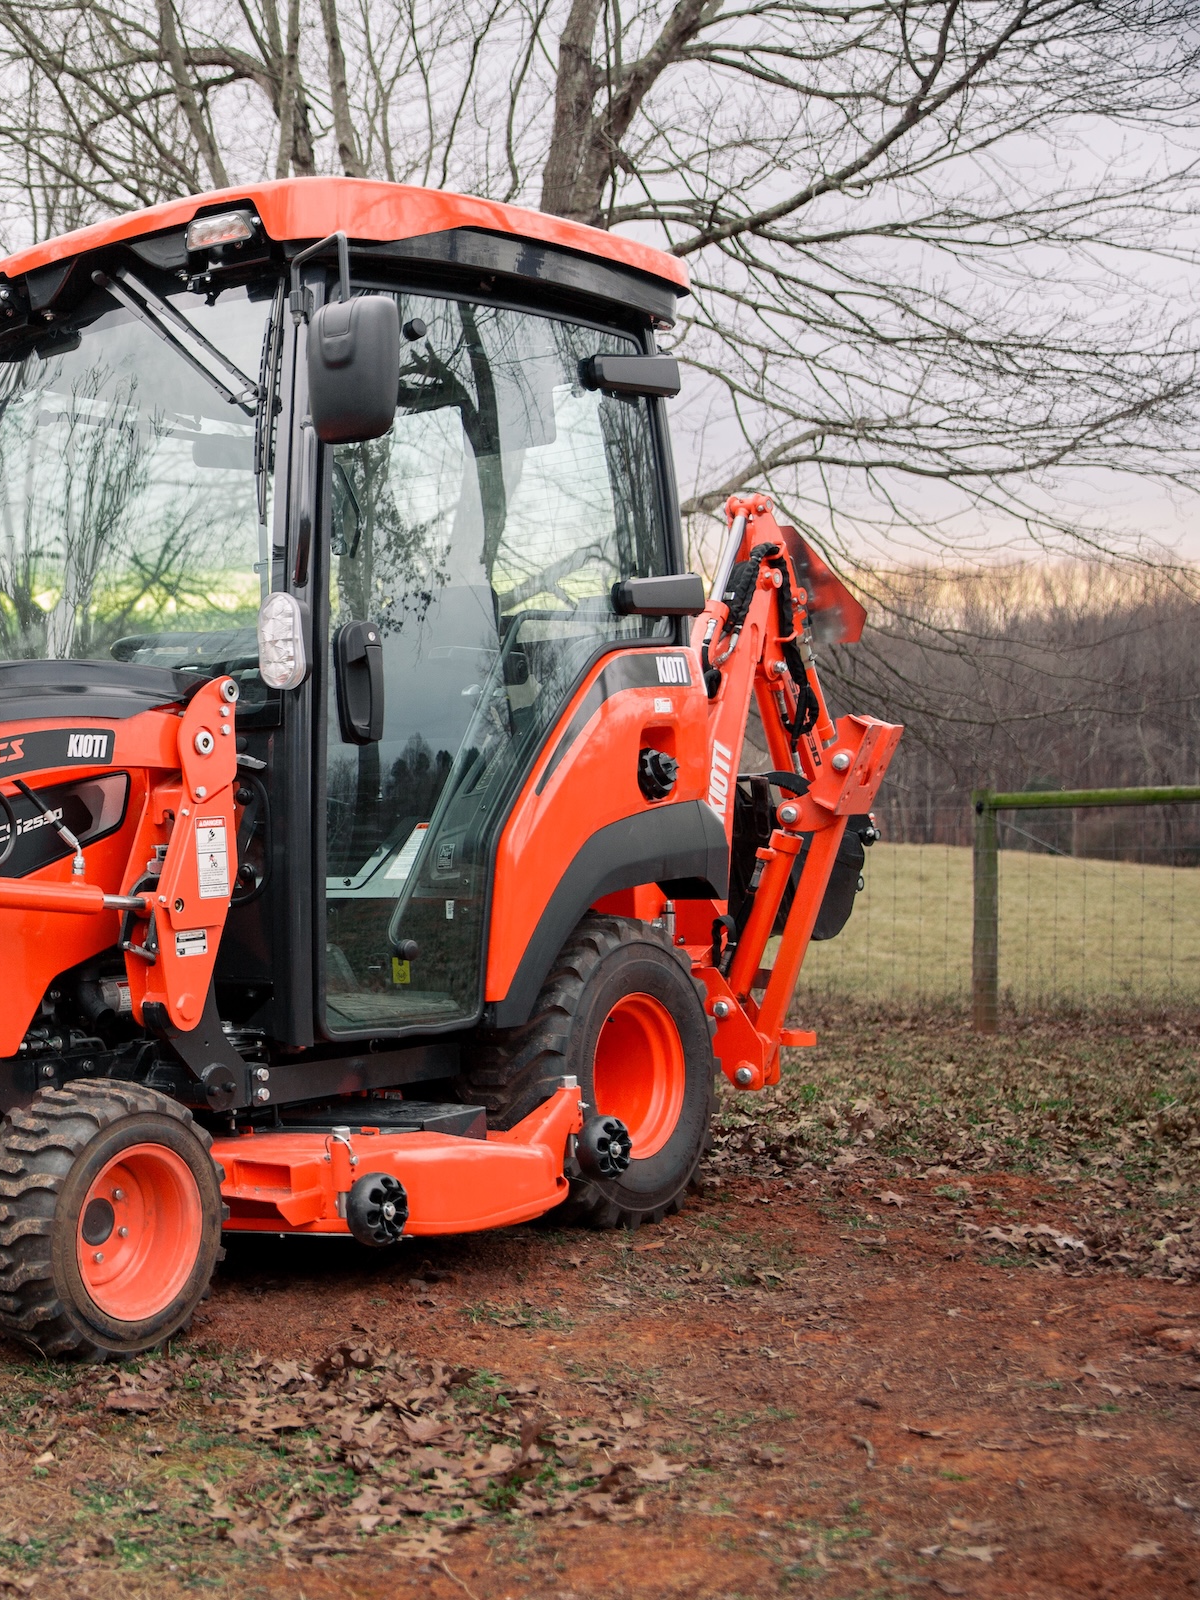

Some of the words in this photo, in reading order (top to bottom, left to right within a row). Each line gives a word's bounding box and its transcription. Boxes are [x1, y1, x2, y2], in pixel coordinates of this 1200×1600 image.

[655, 656, 688, 683] KIOTI
[66, 733, 108, 759] KIOTI
[708, 739, 732, 825] KIOTI
